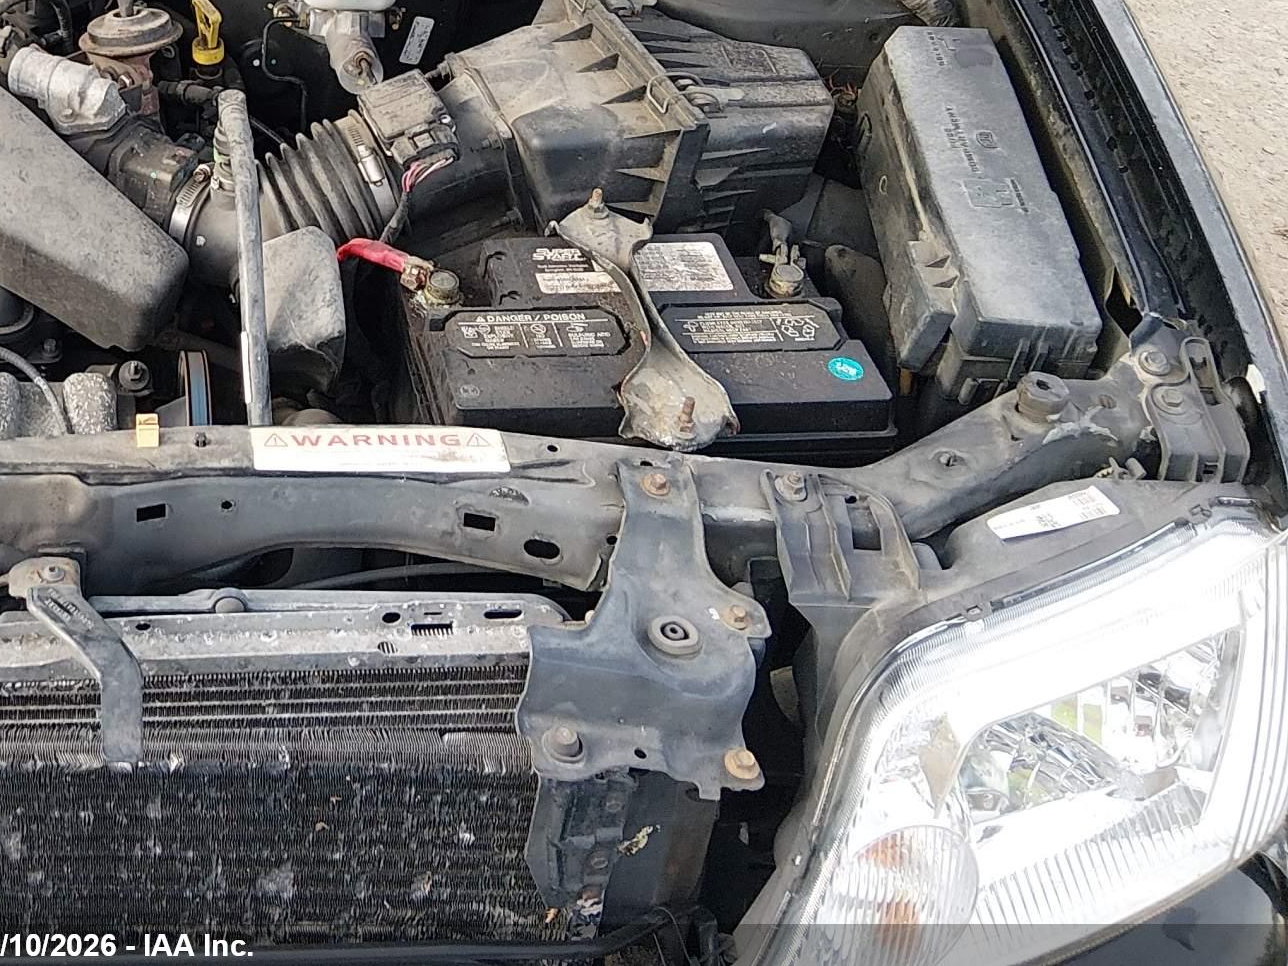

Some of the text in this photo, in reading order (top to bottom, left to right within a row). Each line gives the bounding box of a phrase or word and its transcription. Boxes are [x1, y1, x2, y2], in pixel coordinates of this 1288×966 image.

[946, 106, 980, 172] COMPARTMENT
[486, 314, 533, 323] DANGER
[544, 313, 586, 322] POISON
[291, 433, 462, 448] WARNING
